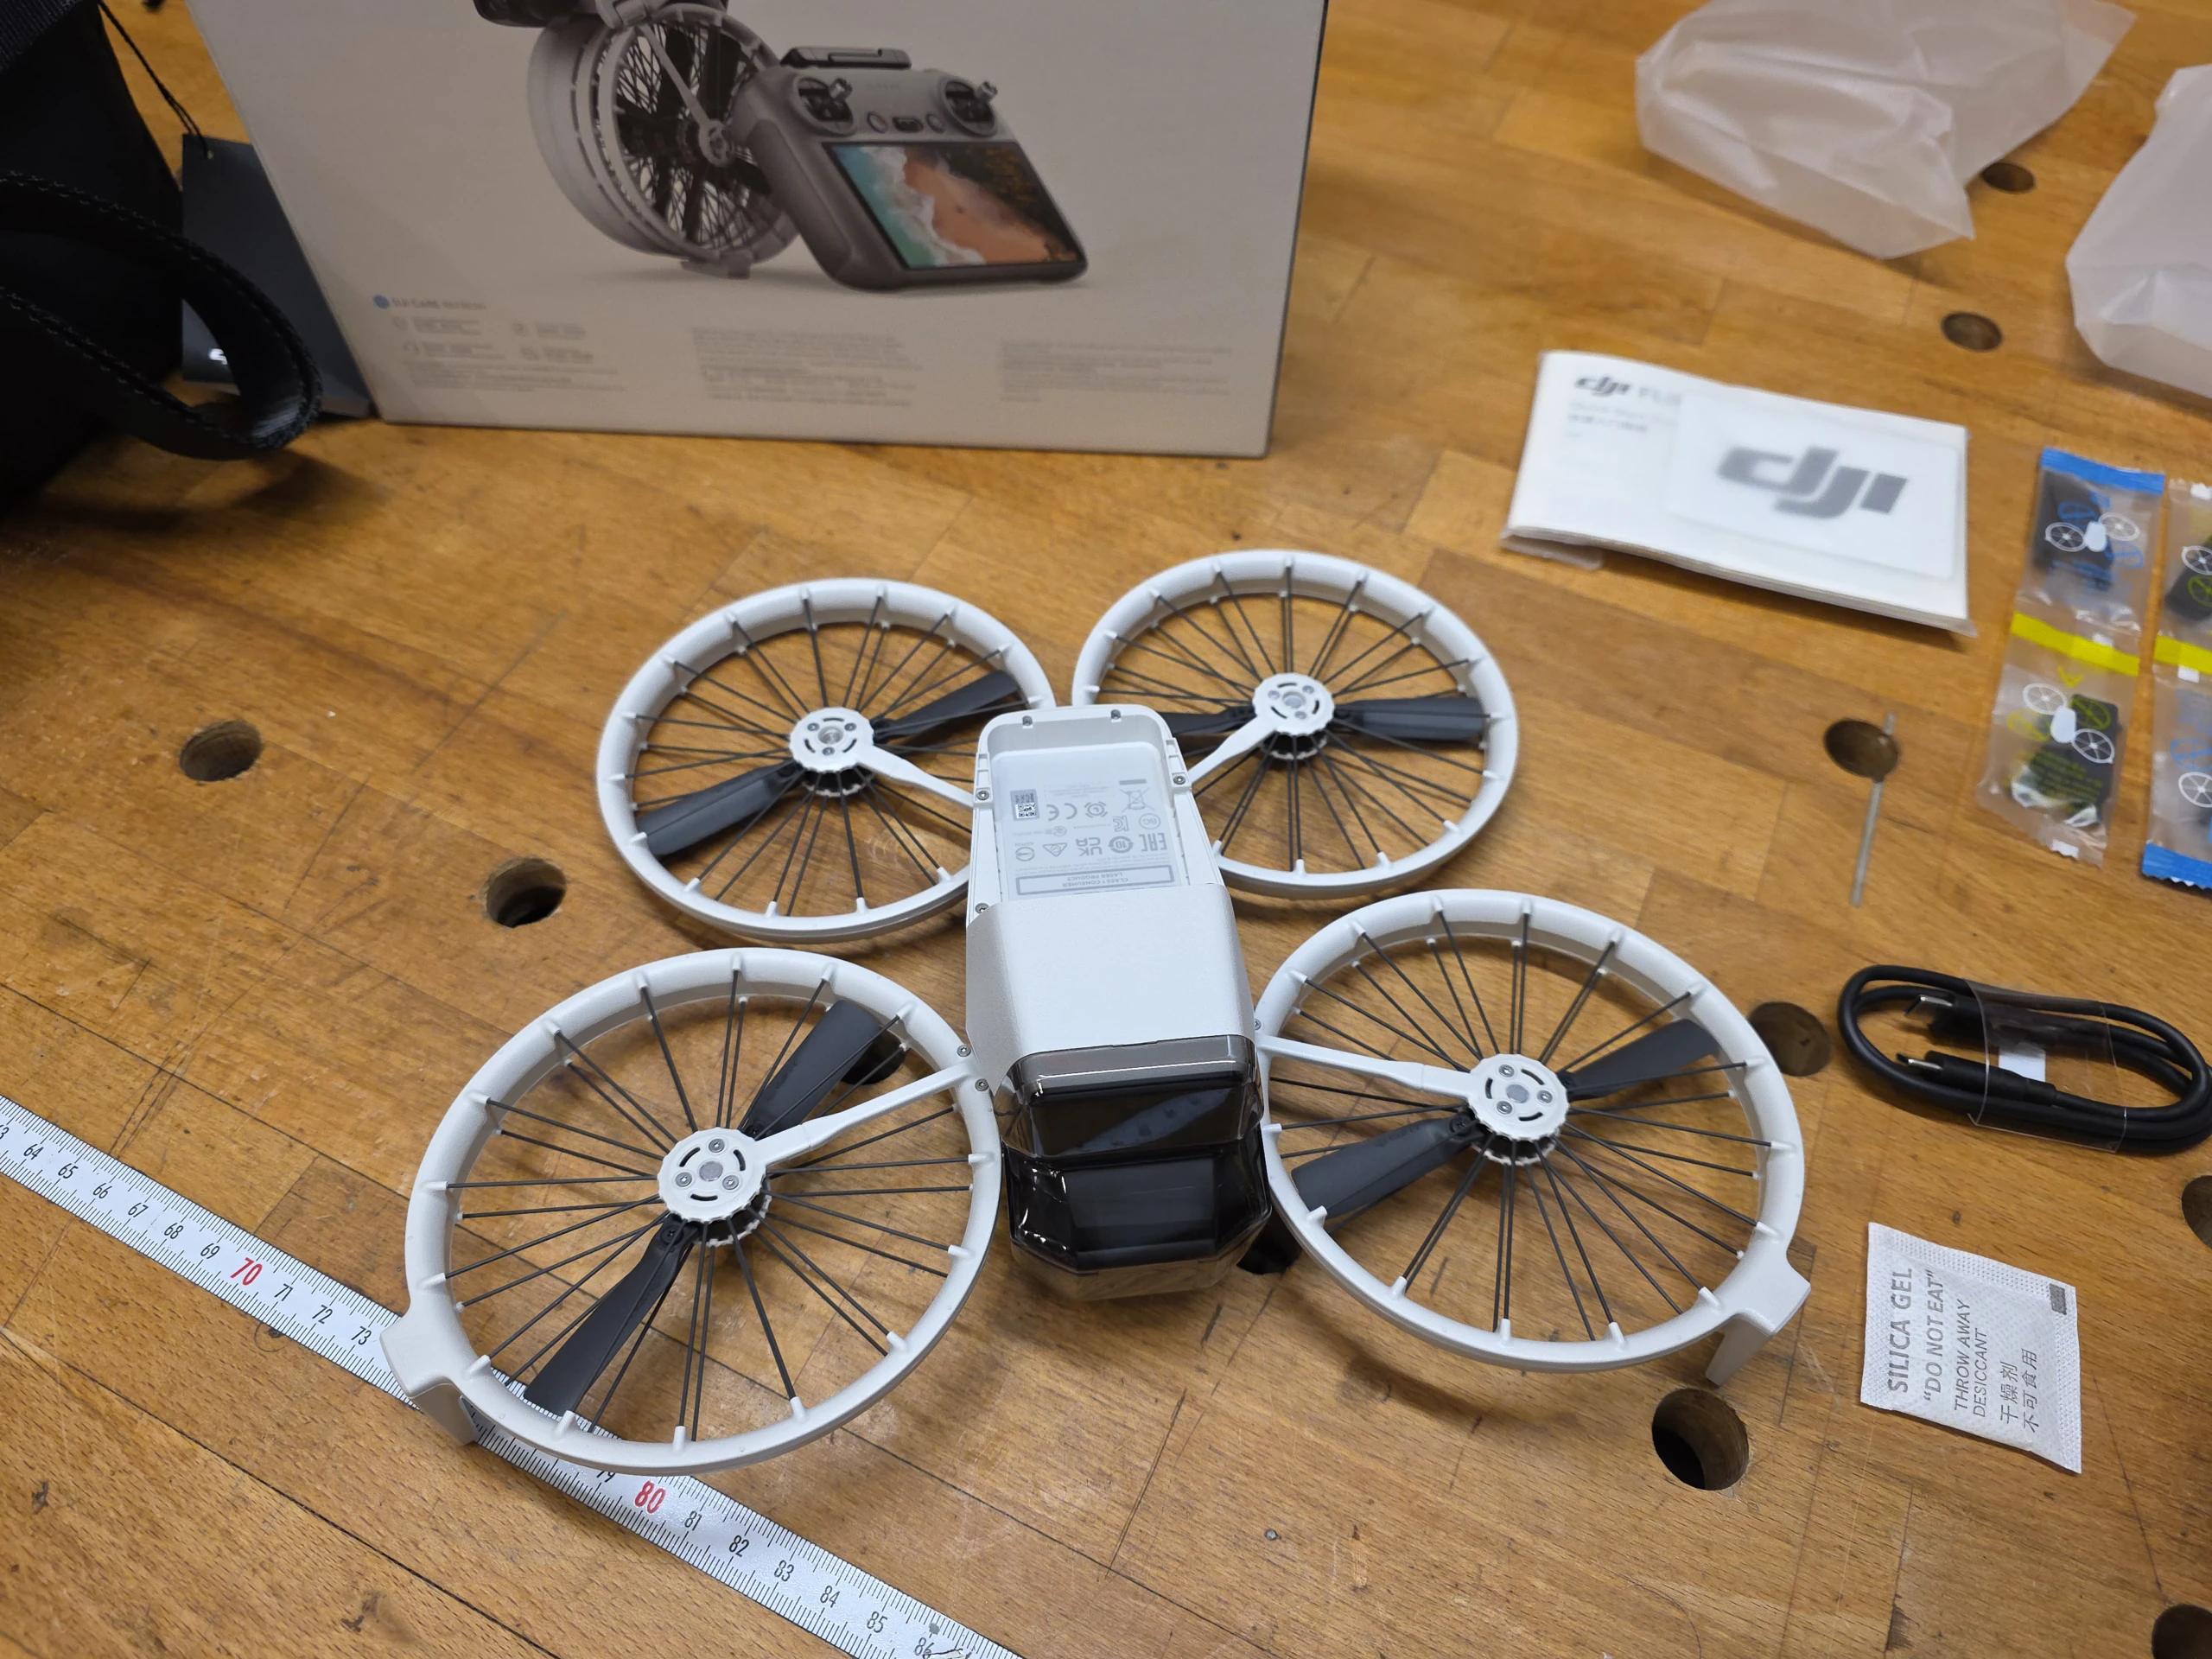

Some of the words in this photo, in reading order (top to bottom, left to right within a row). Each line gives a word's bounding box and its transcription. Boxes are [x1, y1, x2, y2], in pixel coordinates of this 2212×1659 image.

[1076, 837, 1101, 847] CA
[1078, 847, 1103, 856] UK
[0, 1124, 10, 1140] 3
[23, 1144, 44, 1160] 64
[58, 1163, 79, 1179] 65
[92, 1183, 113, 1199] 66
[128, 1203, 149, 1218] 67
[164, 1223, 184, 1239] 68
[200, 1243, 220, 1260] 69
[231, 1257, 263, 1286] 70
[274, 1283, 294, 1302] 71
[312, 1305, 333, 1325] 72
[351, 1325, 372, 1345] 73
[1891, 1268, 1911, 1312] GEL
[1926, 1318, 1943, 1357] NOT
[1956, 1299, 1970, 1349] AWAY
[1888, 1319, 1910, 1393] SILICA
[1954, 1351, 1971, 1411] THROW
[1973, 1328, 1988, 1417] DESICCANT
[1999, 1360, 2019, 1425] 干燥剂
[2021, 1348, 2039, 1433] 不可食用
[634, 1480, 666, 1514] 80
[684, 1510, 701, 1531] 81
[728, 1535, 749, 1557] 82
[774, 1560, 794, 1582] 83
[820, 1586, 841, 1608] 84
[867, 1611, 887, 1633] 85
[913, 1637, 935, 1659] 86
